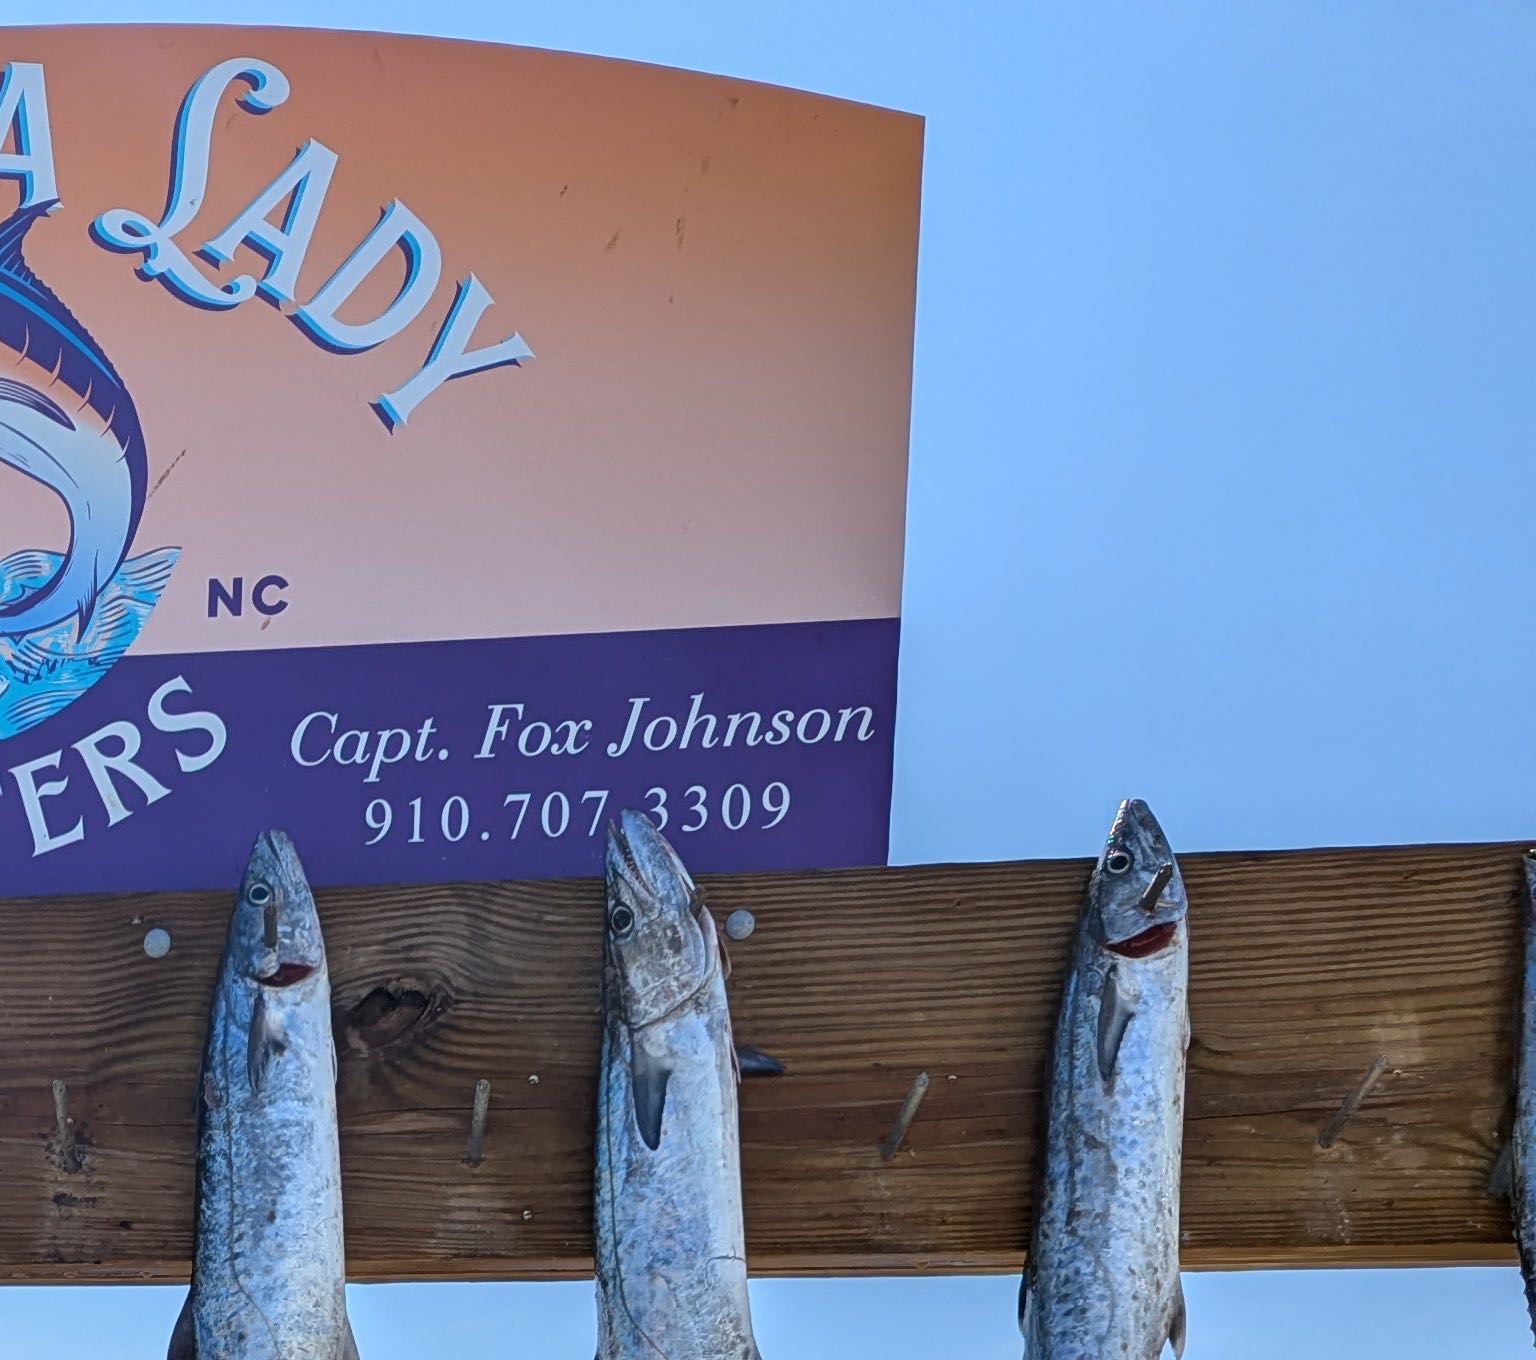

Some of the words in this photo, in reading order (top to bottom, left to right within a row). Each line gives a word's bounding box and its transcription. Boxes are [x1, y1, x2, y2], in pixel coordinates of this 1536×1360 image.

[89, 56, 536, 434] LADY
[208, 575, 290, 618] NC
[291, 711, 450, 783] Capt.
[473, 704, 593, 759] Fox
[607, 693, 875, 757] Johnson
[365, 781, 791, 846] 910.7073309
